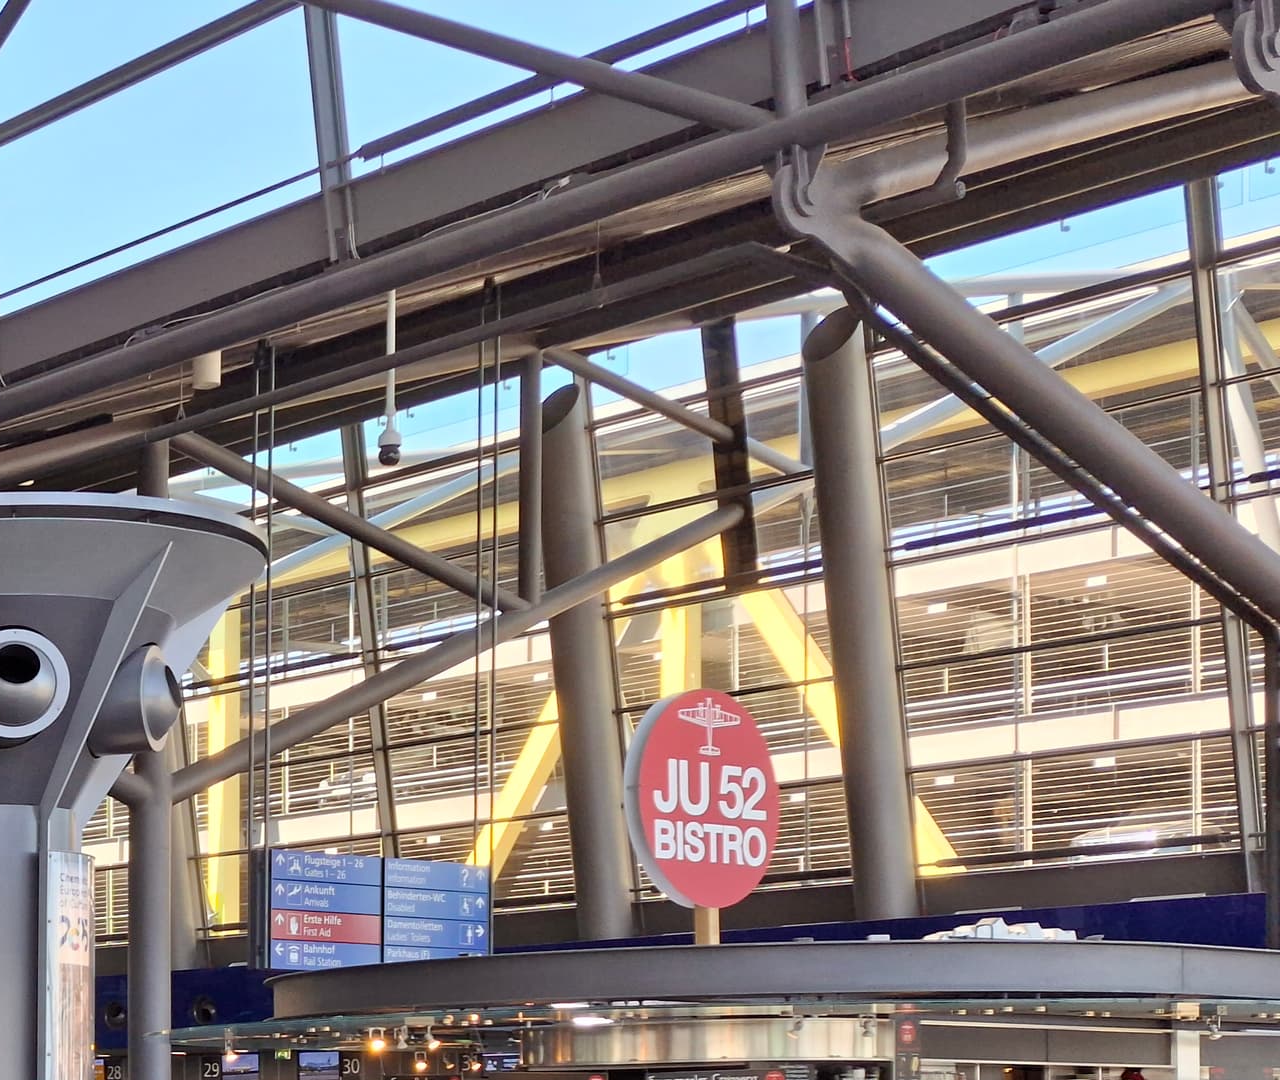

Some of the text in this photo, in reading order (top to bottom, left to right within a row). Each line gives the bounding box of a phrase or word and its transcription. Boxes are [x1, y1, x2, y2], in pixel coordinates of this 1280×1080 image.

[653, 758, 767, 821] JU 52
[653, 819, 767, 867] BISTRO
[304, 855, 341, 869] Flugsteige
[354, 859, 364, 869] 26
[387, 861, 431, 873] Information
[304, 867, 324, 878] Gates
[304, 885, 336, 896] Ankunft
[303, 914, 342, 926] Erste Hilfe
[303, 927, 332, 938] First Aid
[303, 944, 336, 954] Bahnhof
[303, 956, 317, 966] Rail
[204, 1062, 220, 1078] 29
[342, 1058, 360, 1074] 30
[107, 1065, 121, 1080] 28
